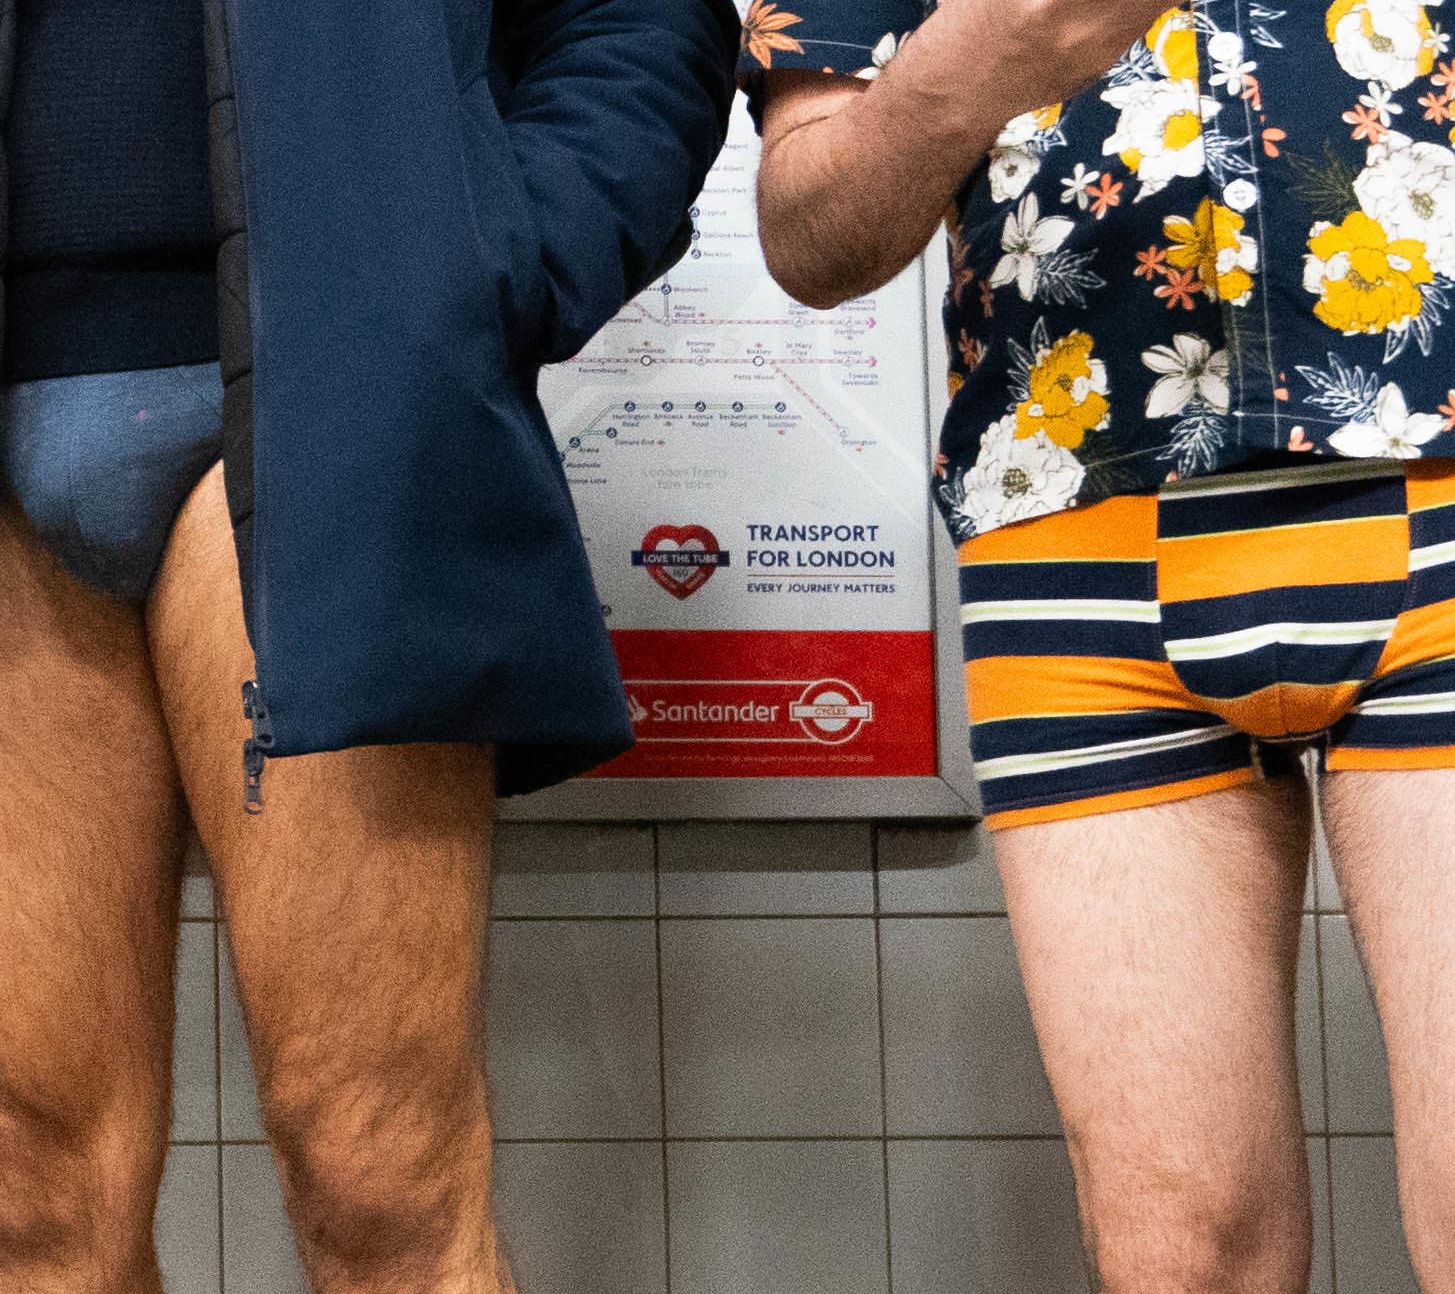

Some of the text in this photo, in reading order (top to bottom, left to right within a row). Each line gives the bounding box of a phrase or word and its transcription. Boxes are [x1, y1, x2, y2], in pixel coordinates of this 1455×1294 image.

[745, 523, 879, 543] TRANSPORT
[642, 553, 719, 564] LOVE THE TUBE
[745, 549, 896, 569] FOR LONDON
[745, 582, 896, 595] EVERY JOURNEY MATTERS
[651, 699, 780, 724] Santander
